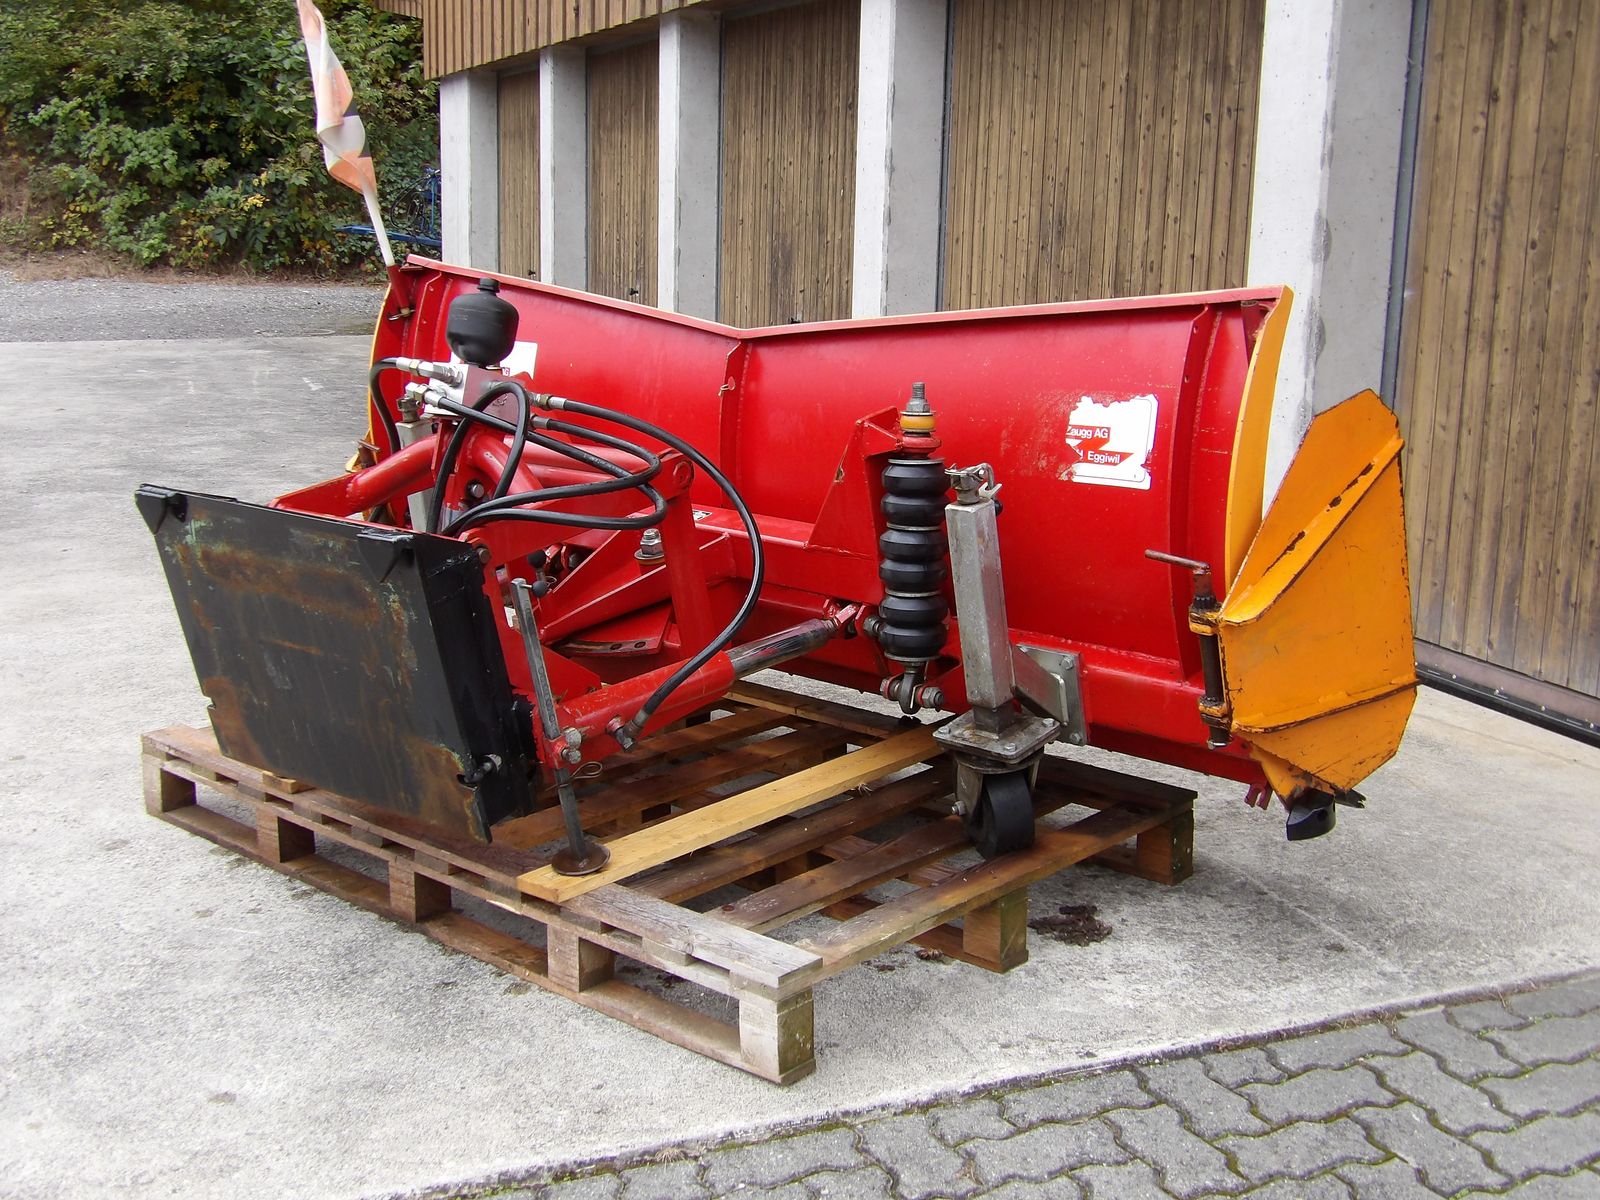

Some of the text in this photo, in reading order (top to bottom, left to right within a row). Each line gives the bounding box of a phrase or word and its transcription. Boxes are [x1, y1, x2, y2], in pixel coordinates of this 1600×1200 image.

[1066, 425, 1109, 439] Zaugg AG
[1087, 450, 1121, 464] Eggiwil
